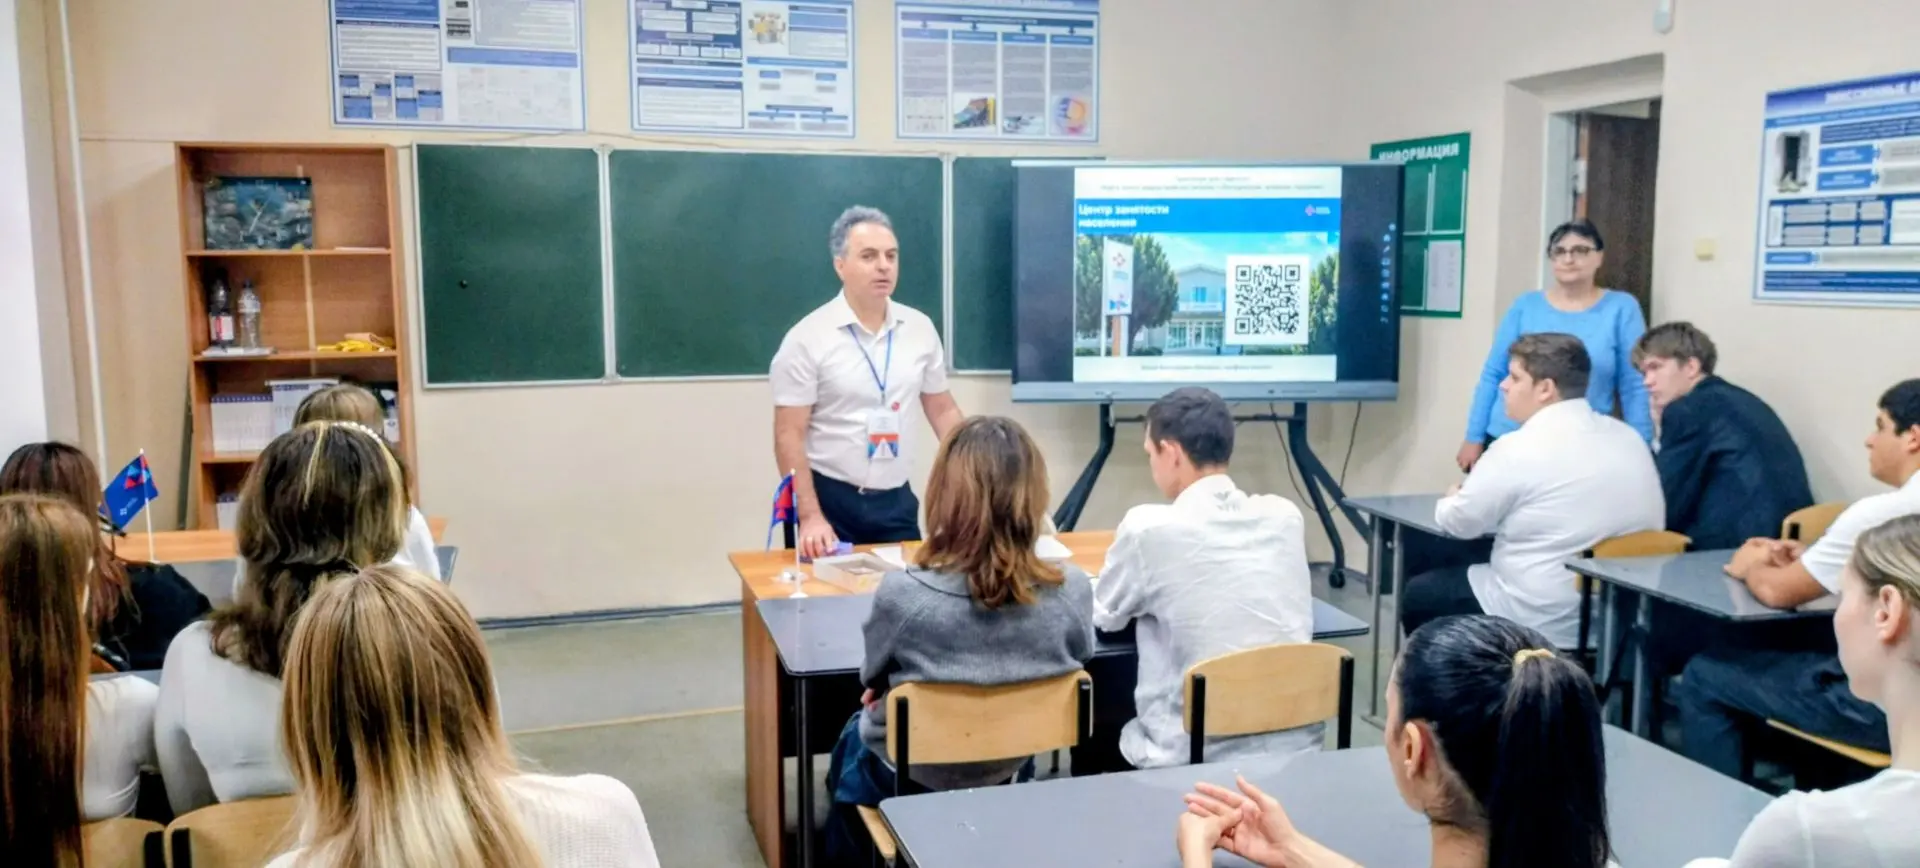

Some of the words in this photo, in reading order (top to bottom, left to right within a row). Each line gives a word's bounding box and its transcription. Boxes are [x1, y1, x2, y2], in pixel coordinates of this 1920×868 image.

[1078, 204, 1113, 217] Центр
[1115, 205, 1170, 215] занятости
[1078, 218, 1137, 228] населения
